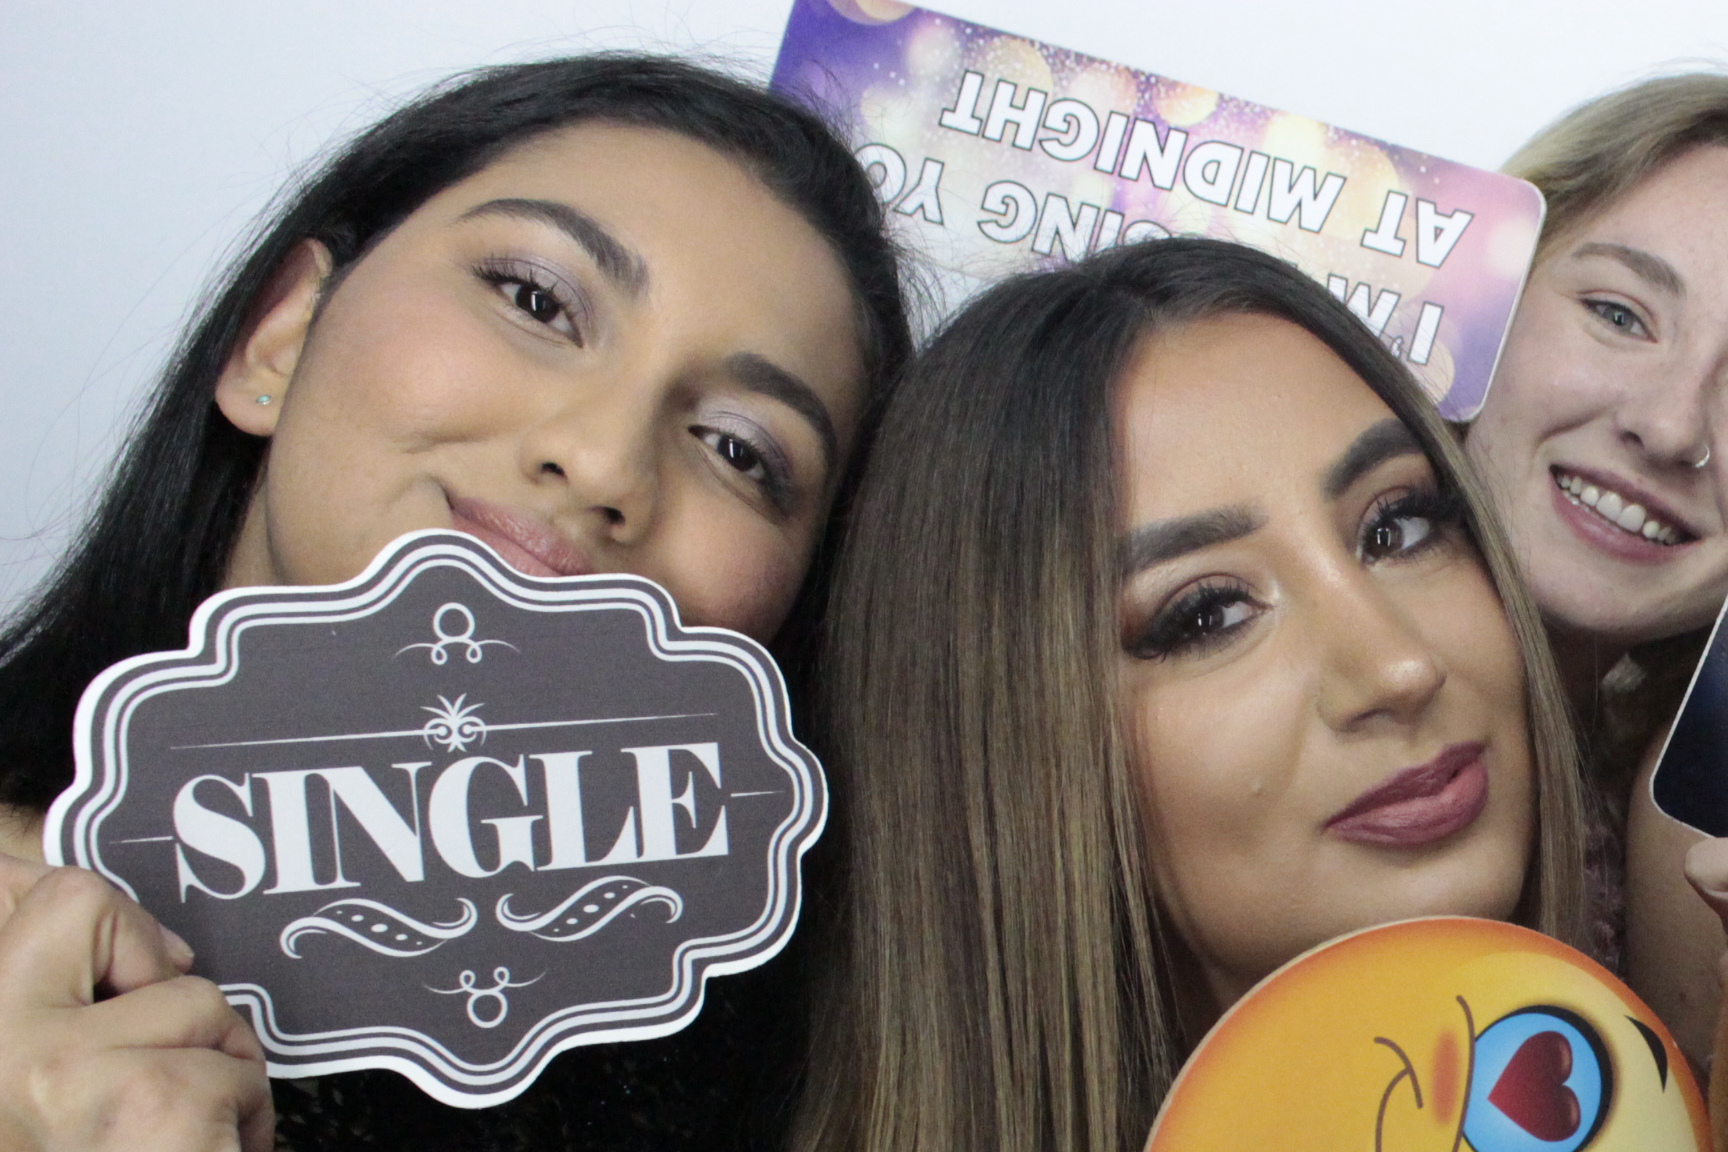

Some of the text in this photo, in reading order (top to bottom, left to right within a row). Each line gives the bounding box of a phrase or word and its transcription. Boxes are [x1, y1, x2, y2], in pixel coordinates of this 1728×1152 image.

[939, 69, 1474, 269] AT MIDNIGHT
[172, 742, 729, 902] SINGLE
